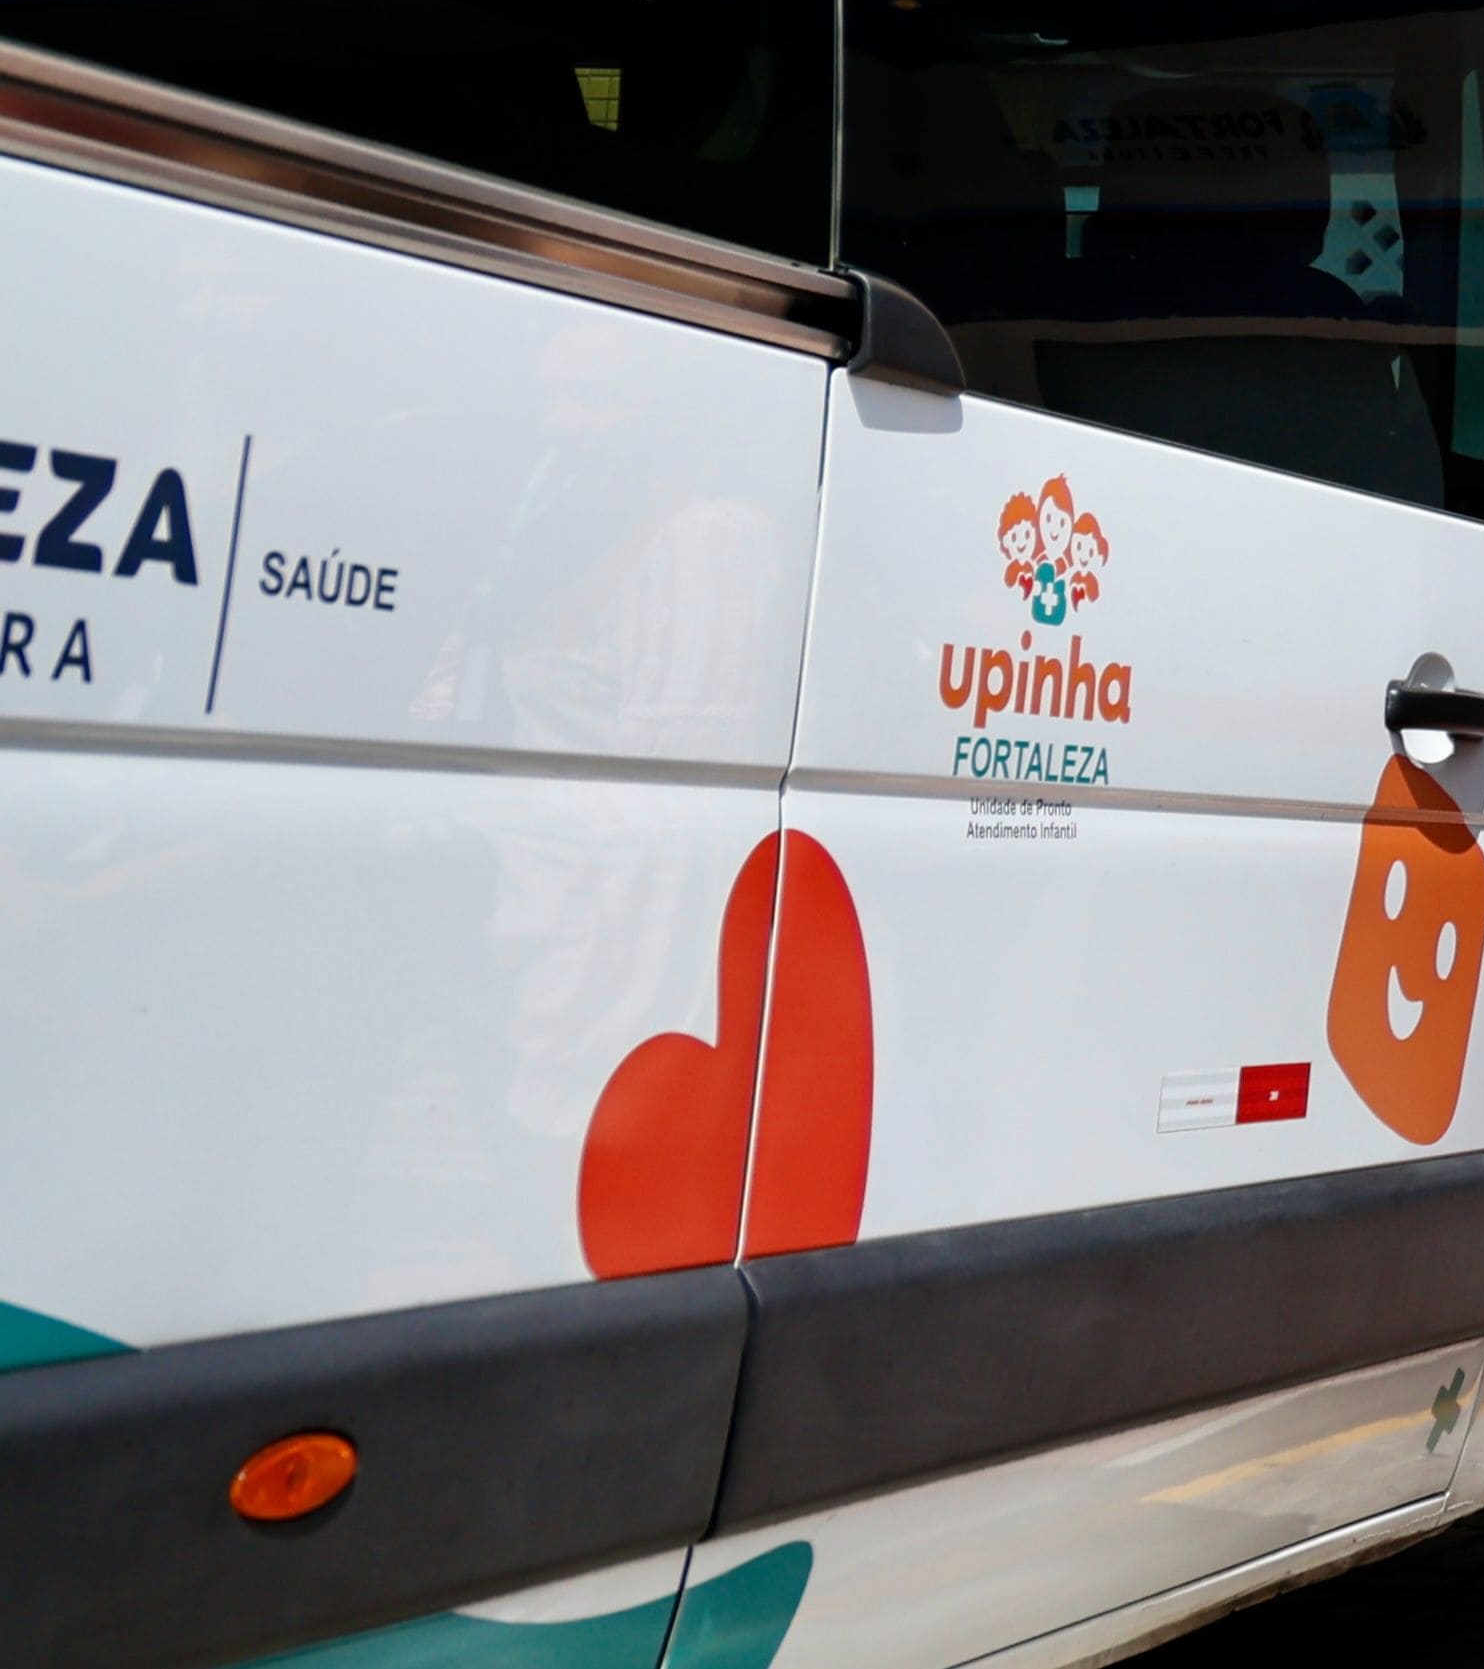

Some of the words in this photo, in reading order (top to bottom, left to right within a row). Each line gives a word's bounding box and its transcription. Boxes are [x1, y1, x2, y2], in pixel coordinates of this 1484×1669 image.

[258, 547, 399, 612] SAÚDE
[938, 629, 1133, 730] upinha
[952, 735, 1110, 786] FORTALEZA
[966, 821, 1038, 840] Atendimento
[1040, 823, 1078, 840] Infantil
[969, 796, 1017, 816] Unidade
[1019, 798, 1033, 816] de
[1035, 797, 1073, 817] Pronto
